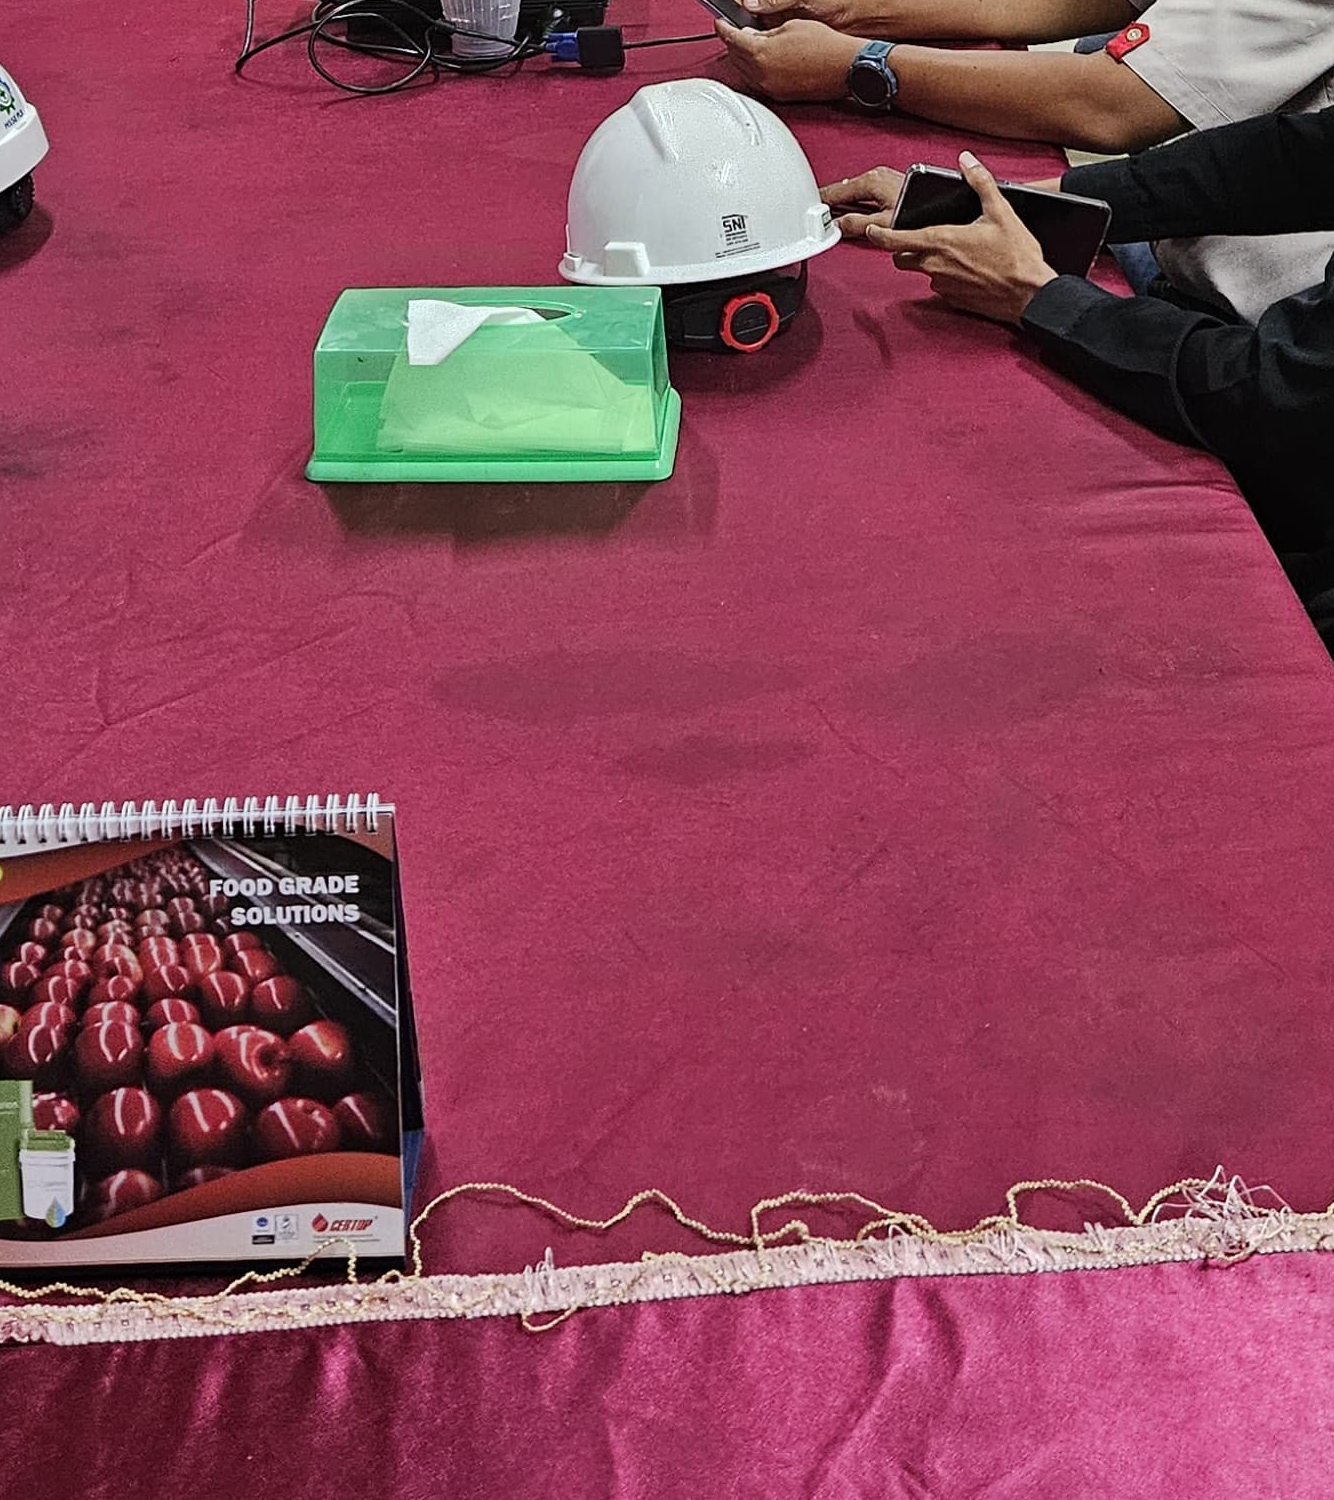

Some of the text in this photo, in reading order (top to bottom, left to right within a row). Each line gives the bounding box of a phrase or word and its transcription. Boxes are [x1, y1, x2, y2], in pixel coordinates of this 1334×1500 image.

[722, 215, 746, 233] SNI
[209, 875, 360, 898] FOOD GRADE
[230, 903, 361, 927] SOLUTIONS
